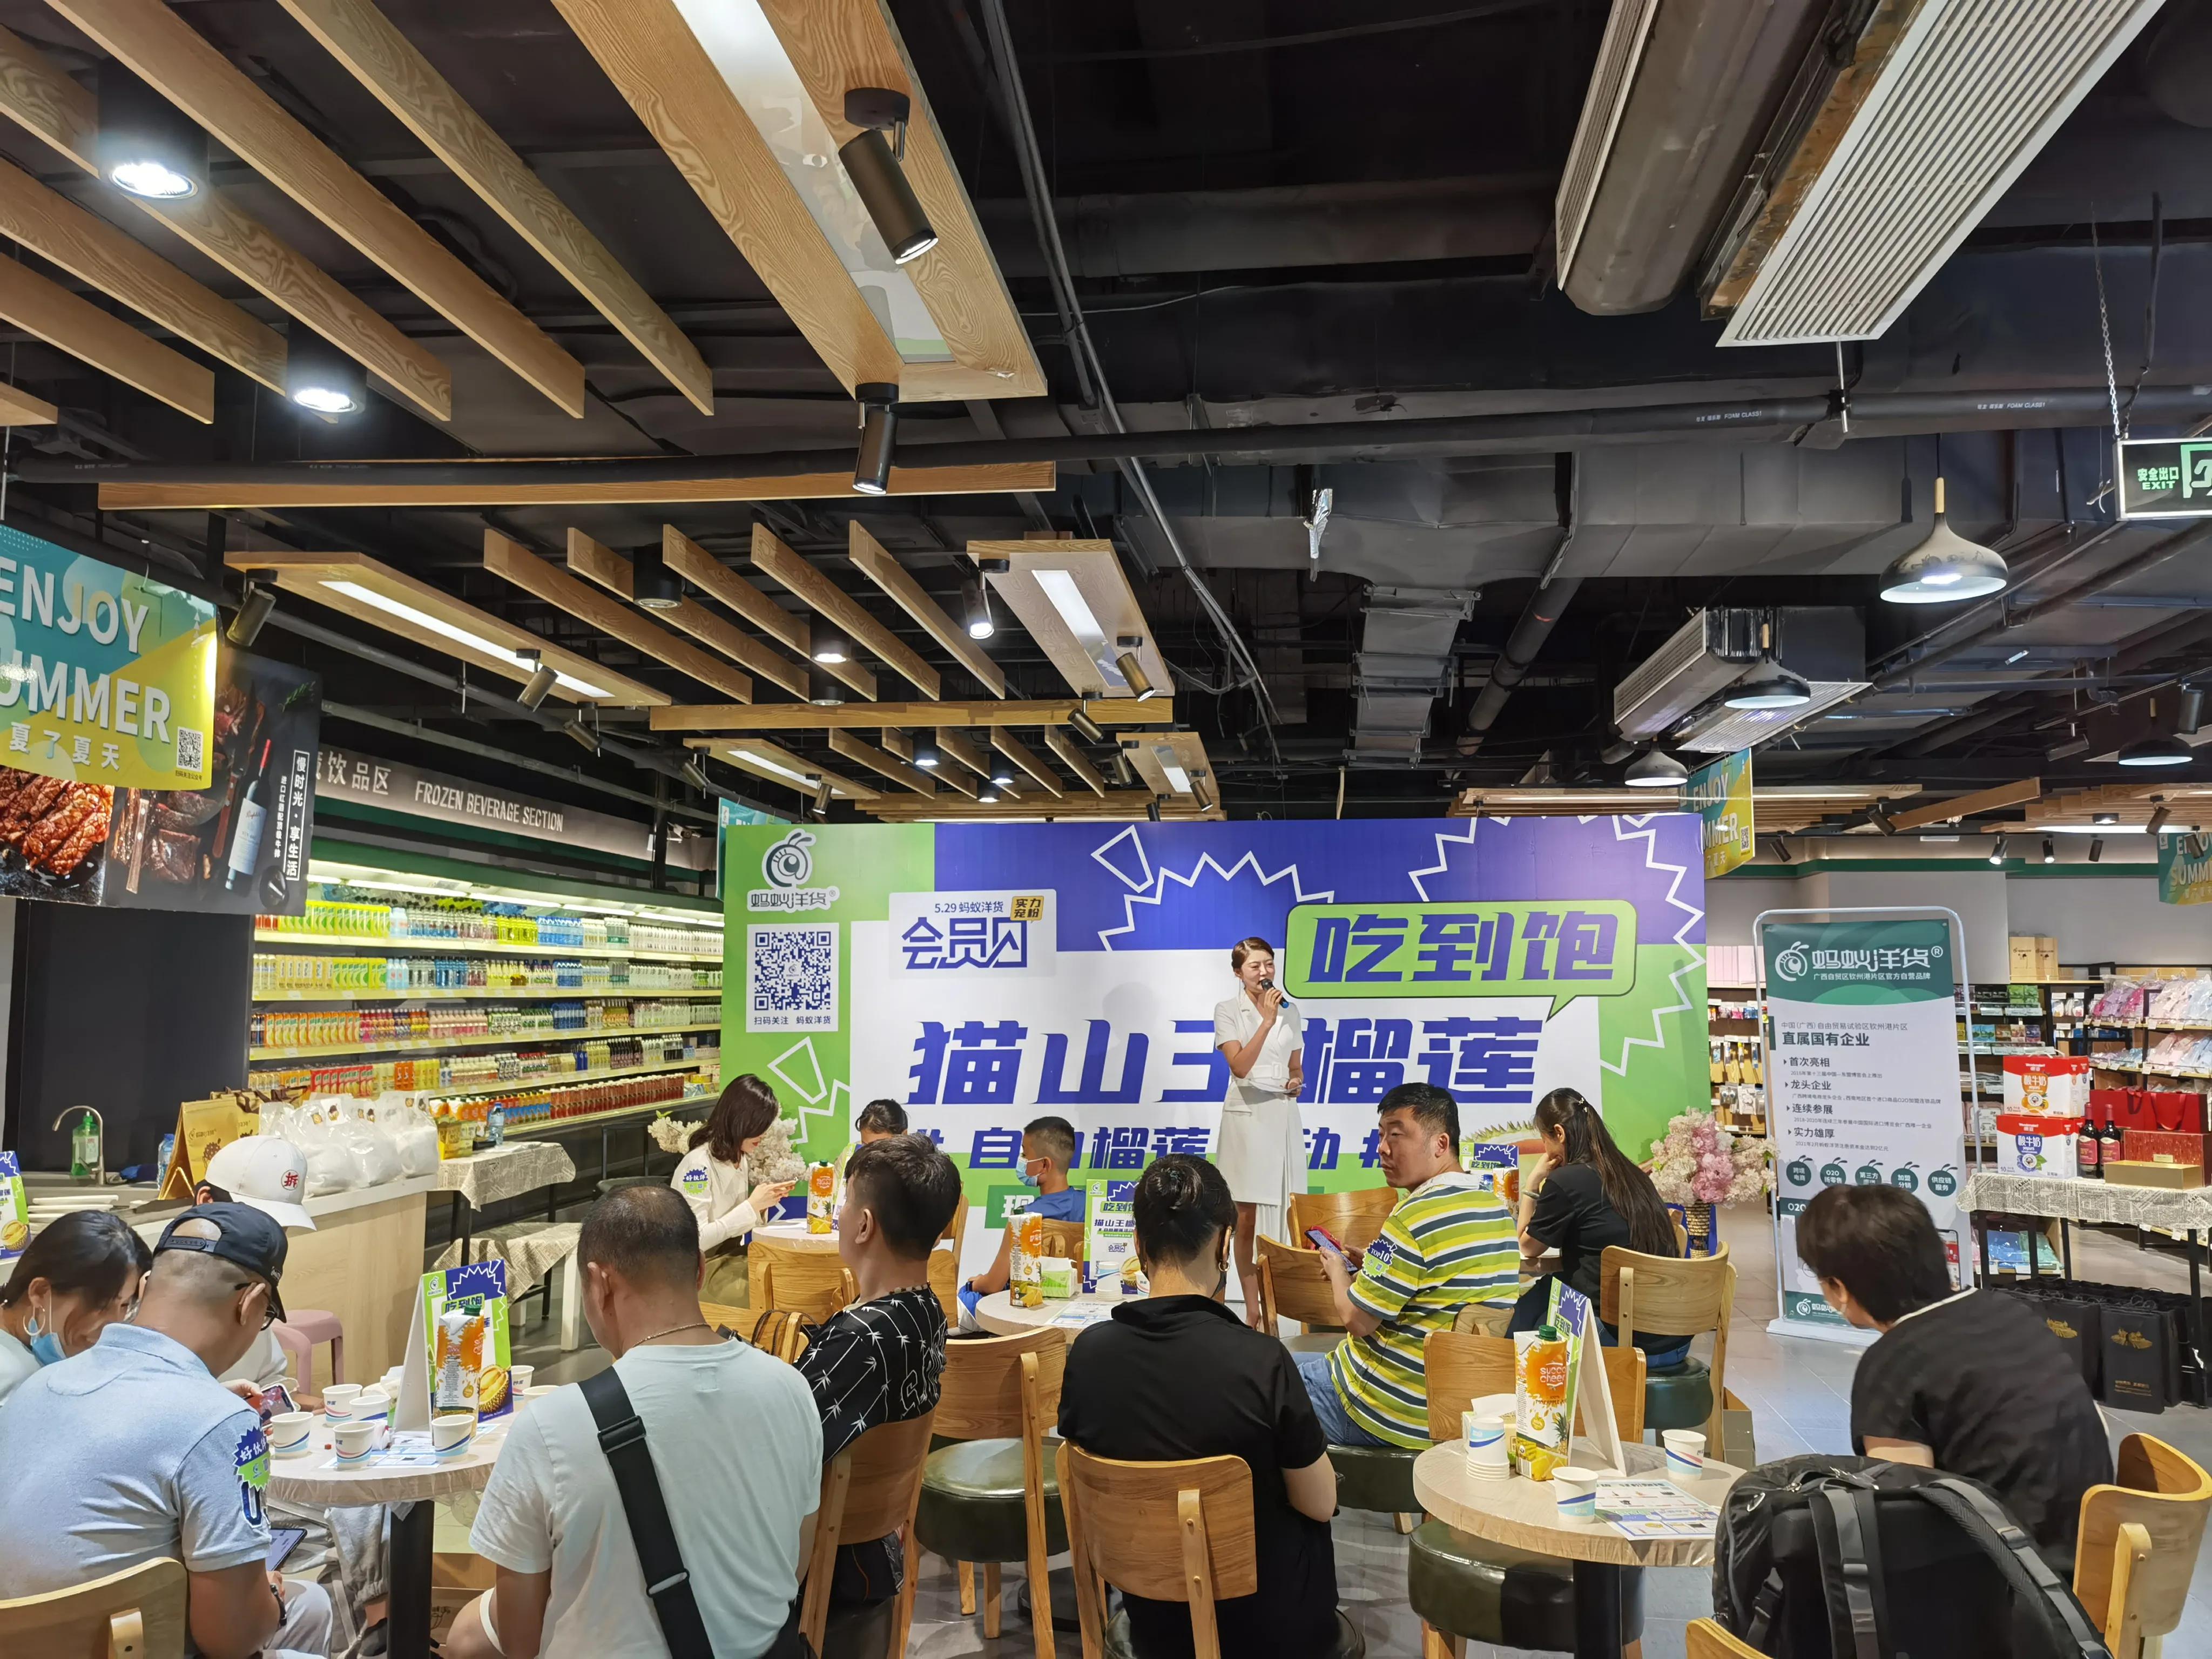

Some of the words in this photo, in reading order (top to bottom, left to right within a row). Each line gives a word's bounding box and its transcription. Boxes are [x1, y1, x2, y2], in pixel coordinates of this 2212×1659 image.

[2137, 467, 2179, 481] 安全出口
[2142, 481, 2175, 490] EXIT
[0, 556, 149, 654] ENJOY
[9, 721, 119, 771] 夏了夏天
[1693, 773, 1728, 812] ENJOY
[415, 780, 464, 811] FROZEN
[467, 793, 520, 823] BEVERAGE
[522, 805, 564, 832] SECTION
[751, 892, 826, 909] 蚂蚁洋货
[1016, 898, 1041, 908] 实力
[935, 903, 957, 913] 5.29
[959, 901, 1003, 913] 蚂蚁洋货
[1014, 908, 1040, 919] 宠粉
[1306, 910, 1619, 983] 吃到饱
[1812, 948, 1931, 972] 蚂蚁洋货
[1813, 972, 1931, 981] 广西自贸区钦州港片区官方自营品牌
[754, 1016, 788, 1026] 扫码关注
[796, 1016, 831, 1025] 蚂蚁洋货
[1782, 1031, 1870, 1046] 直属国有企业
[1789, 1057, 1830, 1068] 首次亮相
[1791, 1080, 1831, 1090] 龙头企业
[1792, 1103, 1833, 1115] 连续参展
[1794, 1127, 1835, 1138] 实力雄厚
[1931, 1176, 1952, 1184] 供应链
